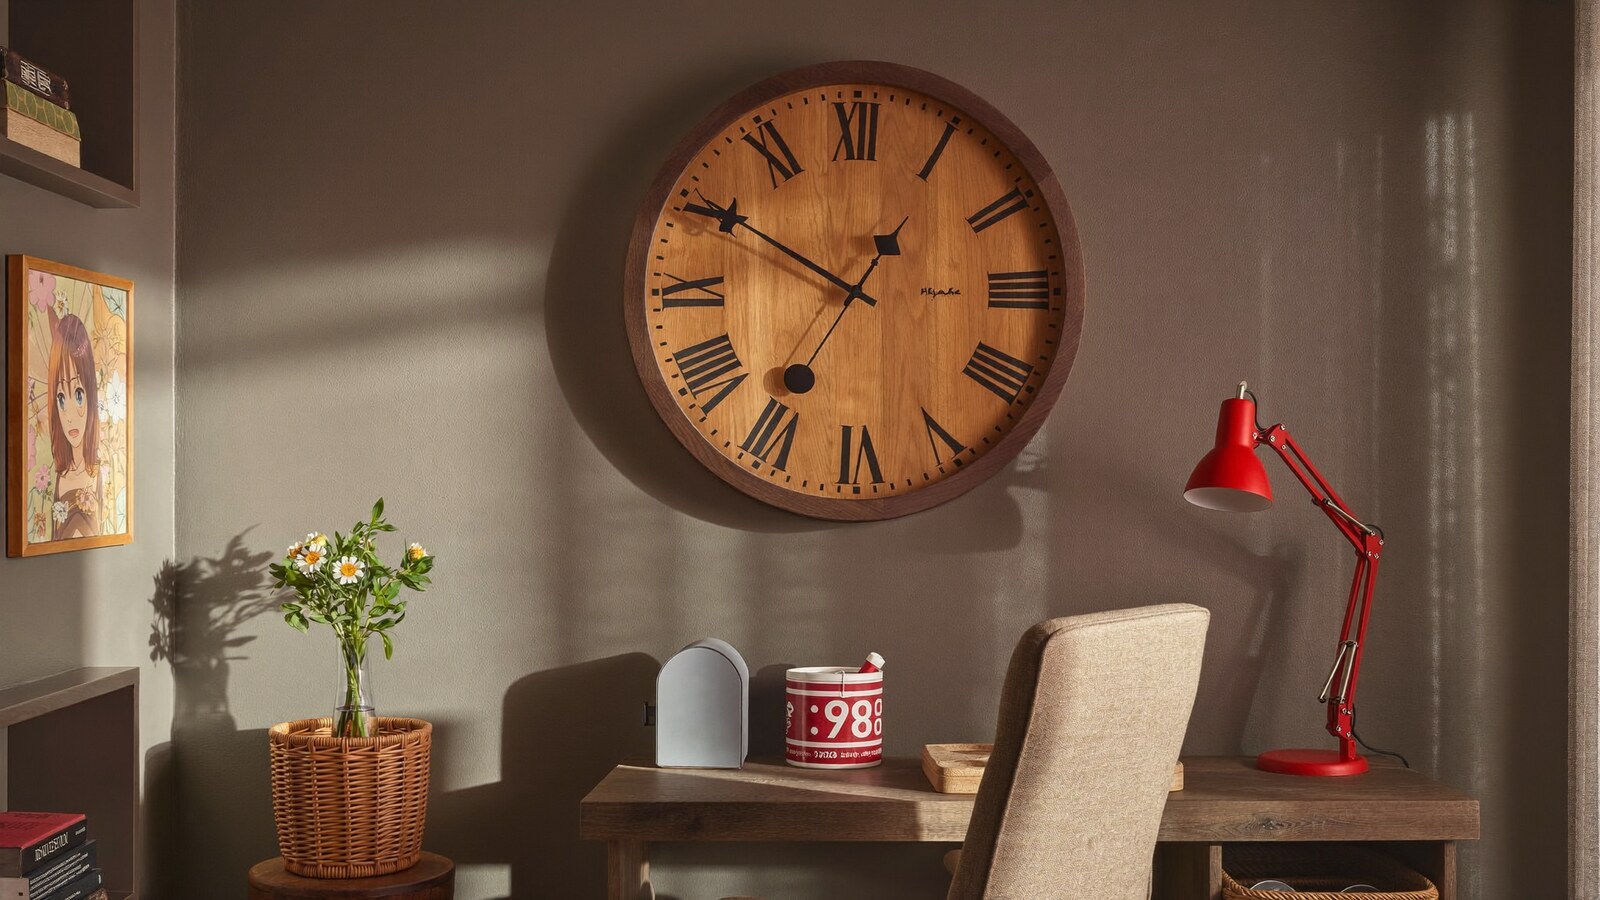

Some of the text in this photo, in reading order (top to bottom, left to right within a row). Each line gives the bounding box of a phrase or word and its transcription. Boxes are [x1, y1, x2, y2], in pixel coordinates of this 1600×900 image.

[741, 118, 806, 190] XI
[832, 101, 881, 161] XII
[965, 186, 1030, 238] II
[920, 406, 967, 467] V
